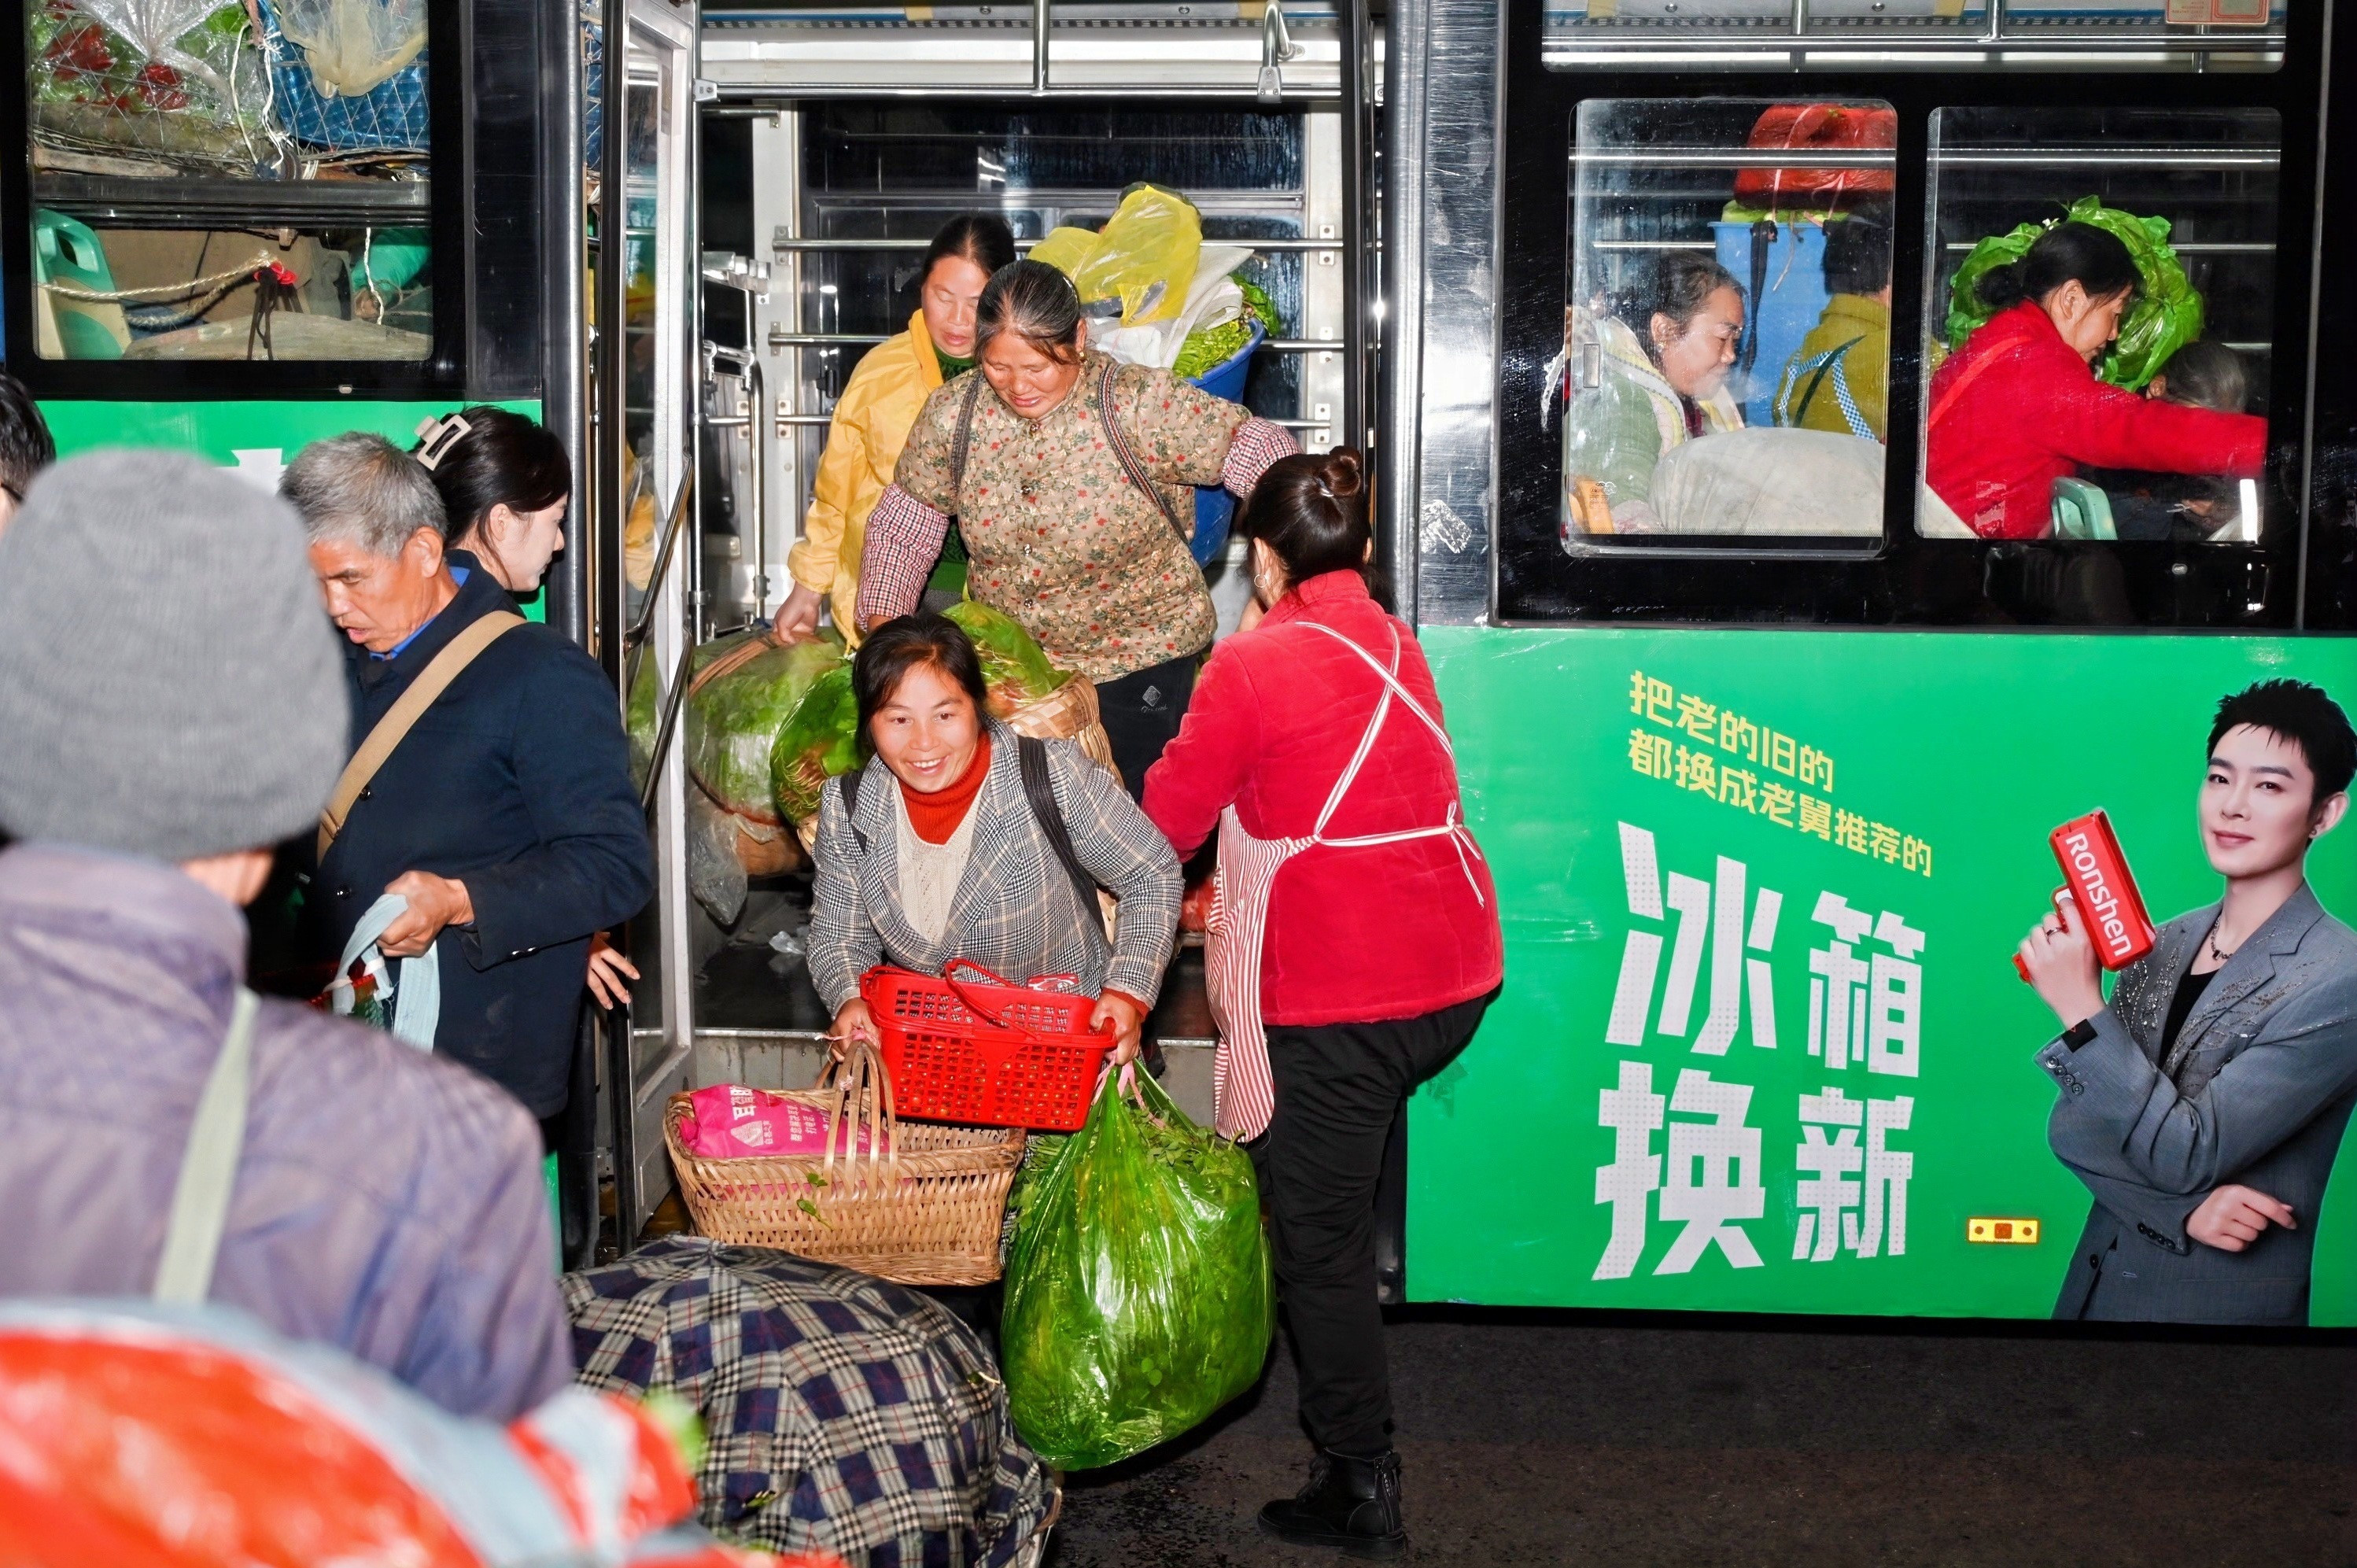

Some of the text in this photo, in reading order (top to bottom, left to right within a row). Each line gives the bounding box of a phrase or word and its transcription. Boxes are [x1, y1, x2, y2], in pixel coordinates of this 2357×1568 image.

[1628, 728, 1931, 877] 都换成老舅推荐的
[1629, 670, 1834, 793] 把老的旧的
[1604, 820, 1926, 1078] 冰箱
[2065, 832, 2132, 957] Ronshen
[1591, 1059, 1916, 1281] 换新
